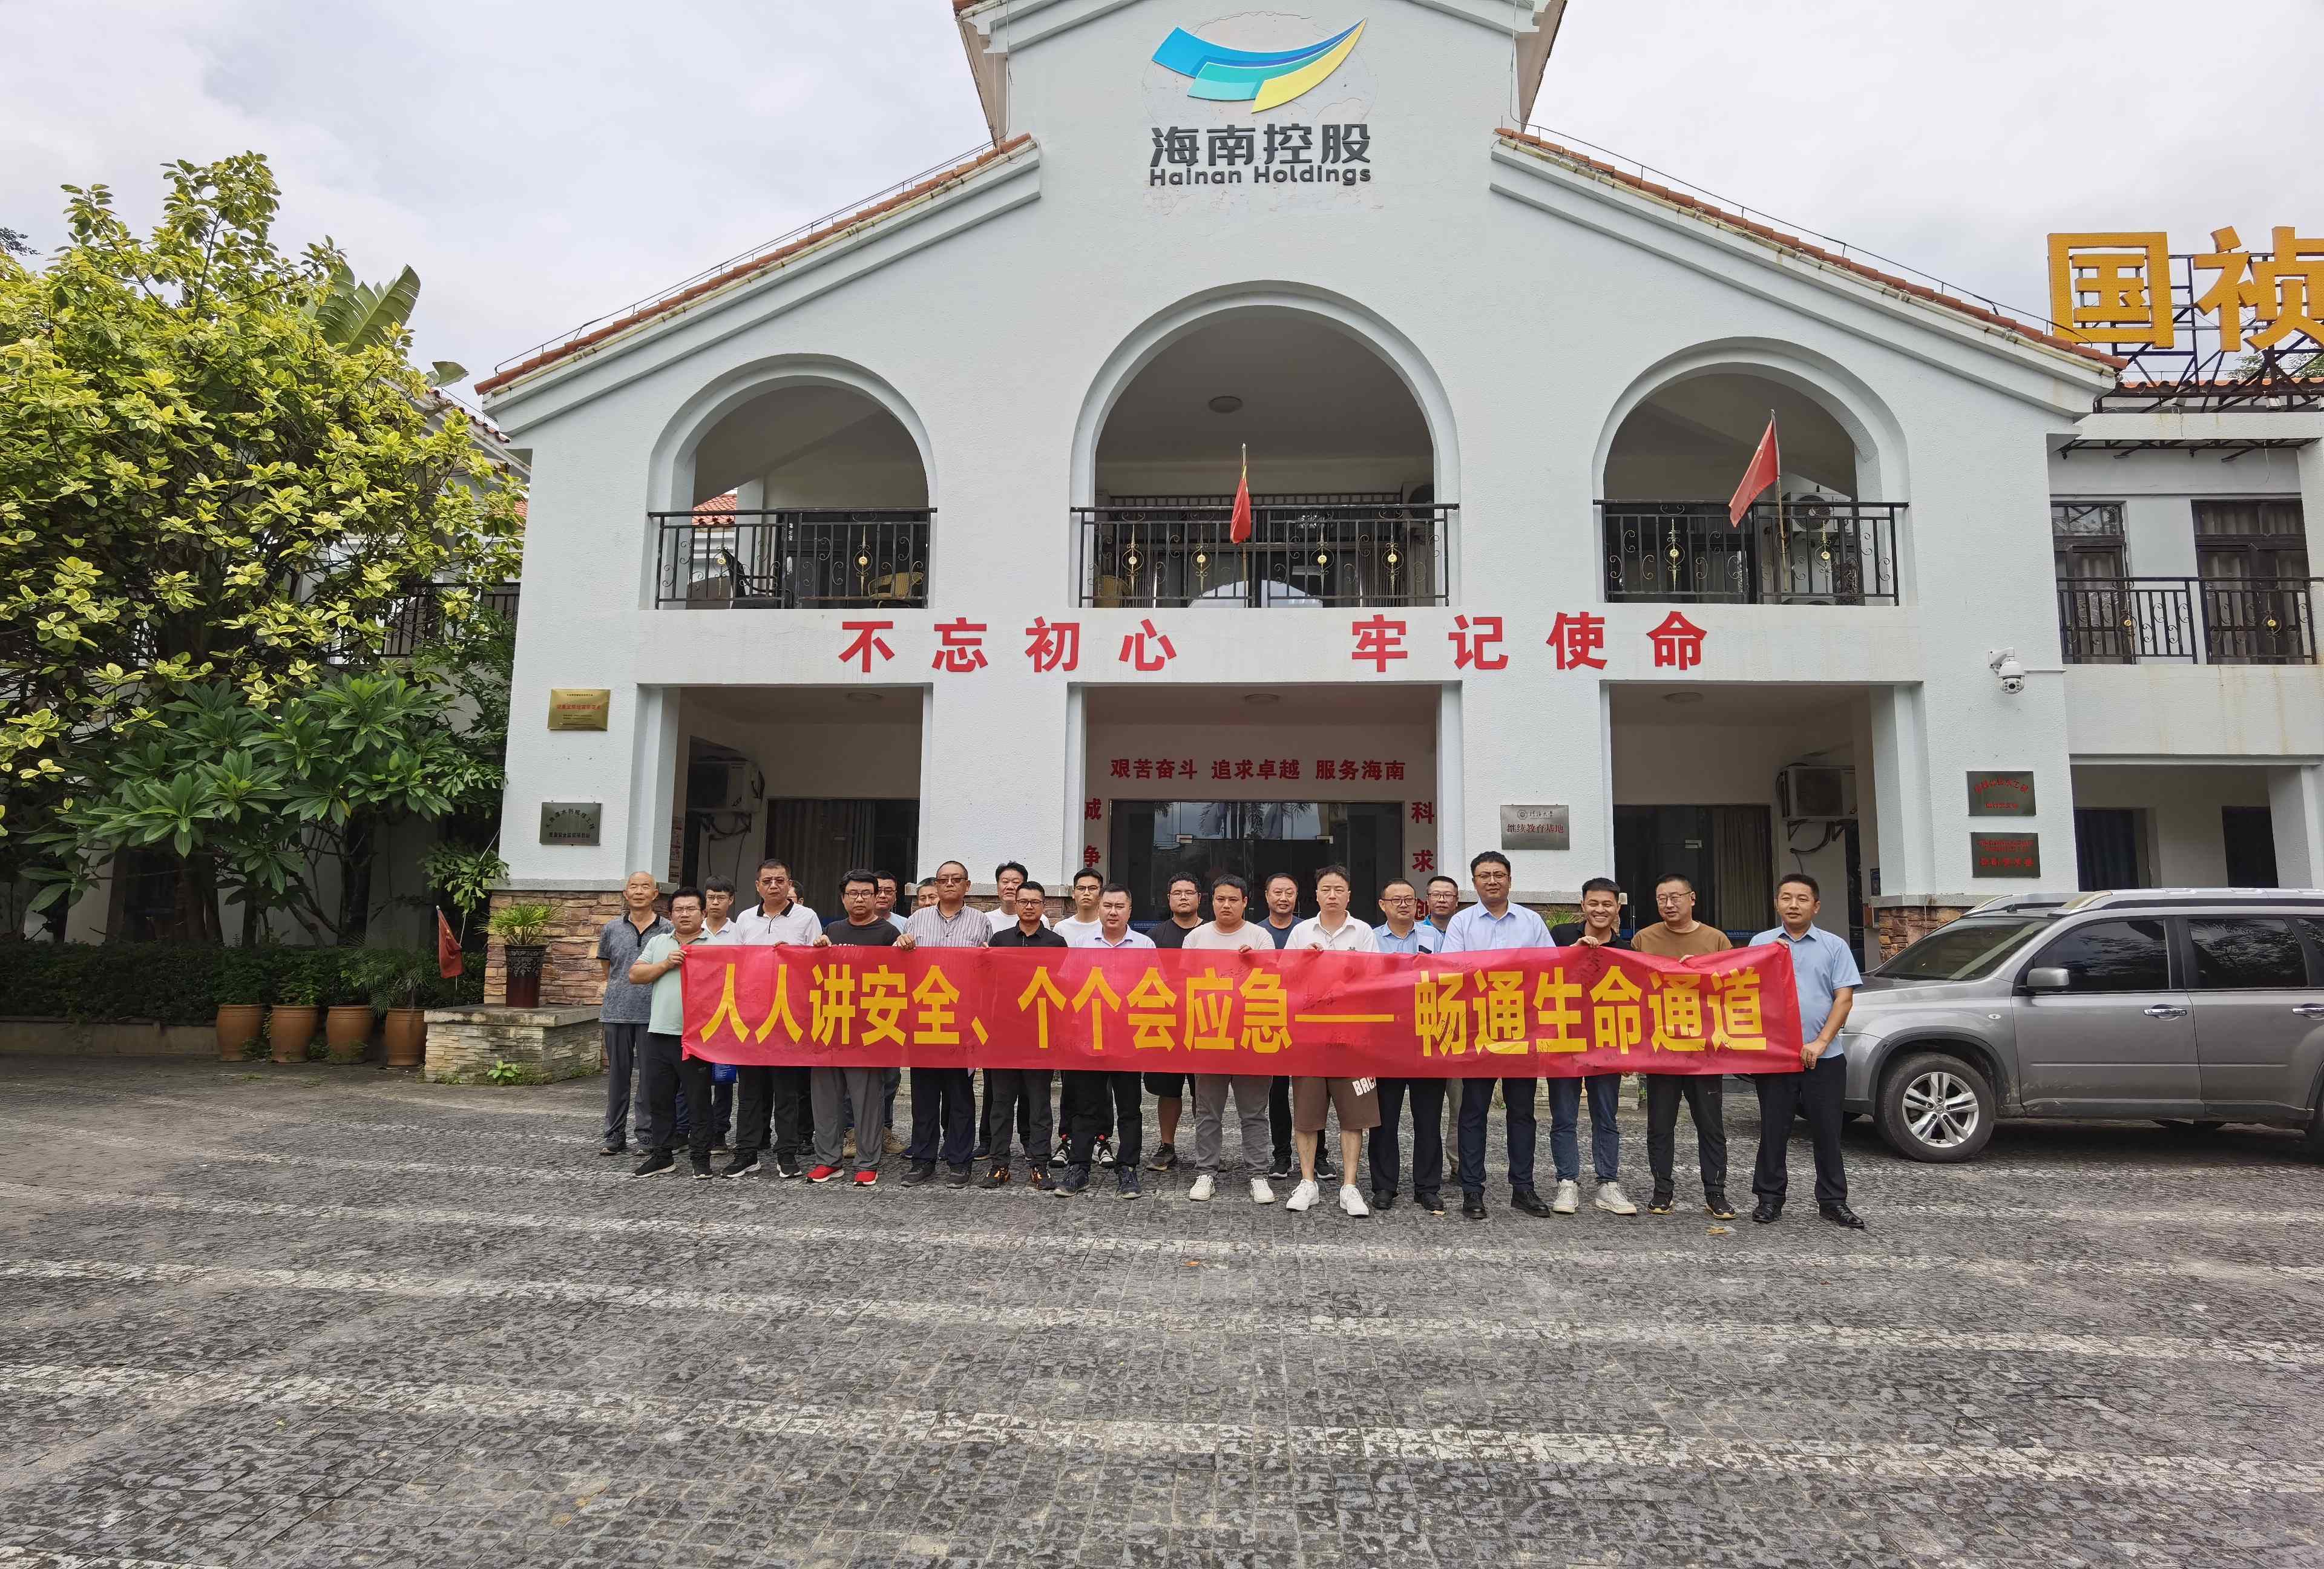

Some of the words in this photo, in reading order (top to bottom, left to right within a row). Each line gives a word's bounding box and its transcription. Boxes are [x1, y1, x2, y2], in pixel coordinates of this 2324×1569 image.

[1151, 123, 1370, 167] 海南控股
[1151, 167, 1242, 186] Hainan
[1255, 165, 1371, 186] Holdings
[838, 616, 1177, 673] 不忘初心
[1351, 610, 1707, 673] 牢记使命
[1110, 758, 1198, 780] 艰苦奋斗
[1211, 759, 1301, 781] 追求卓越
[1315, 759, 1406, 781] 服务海南
